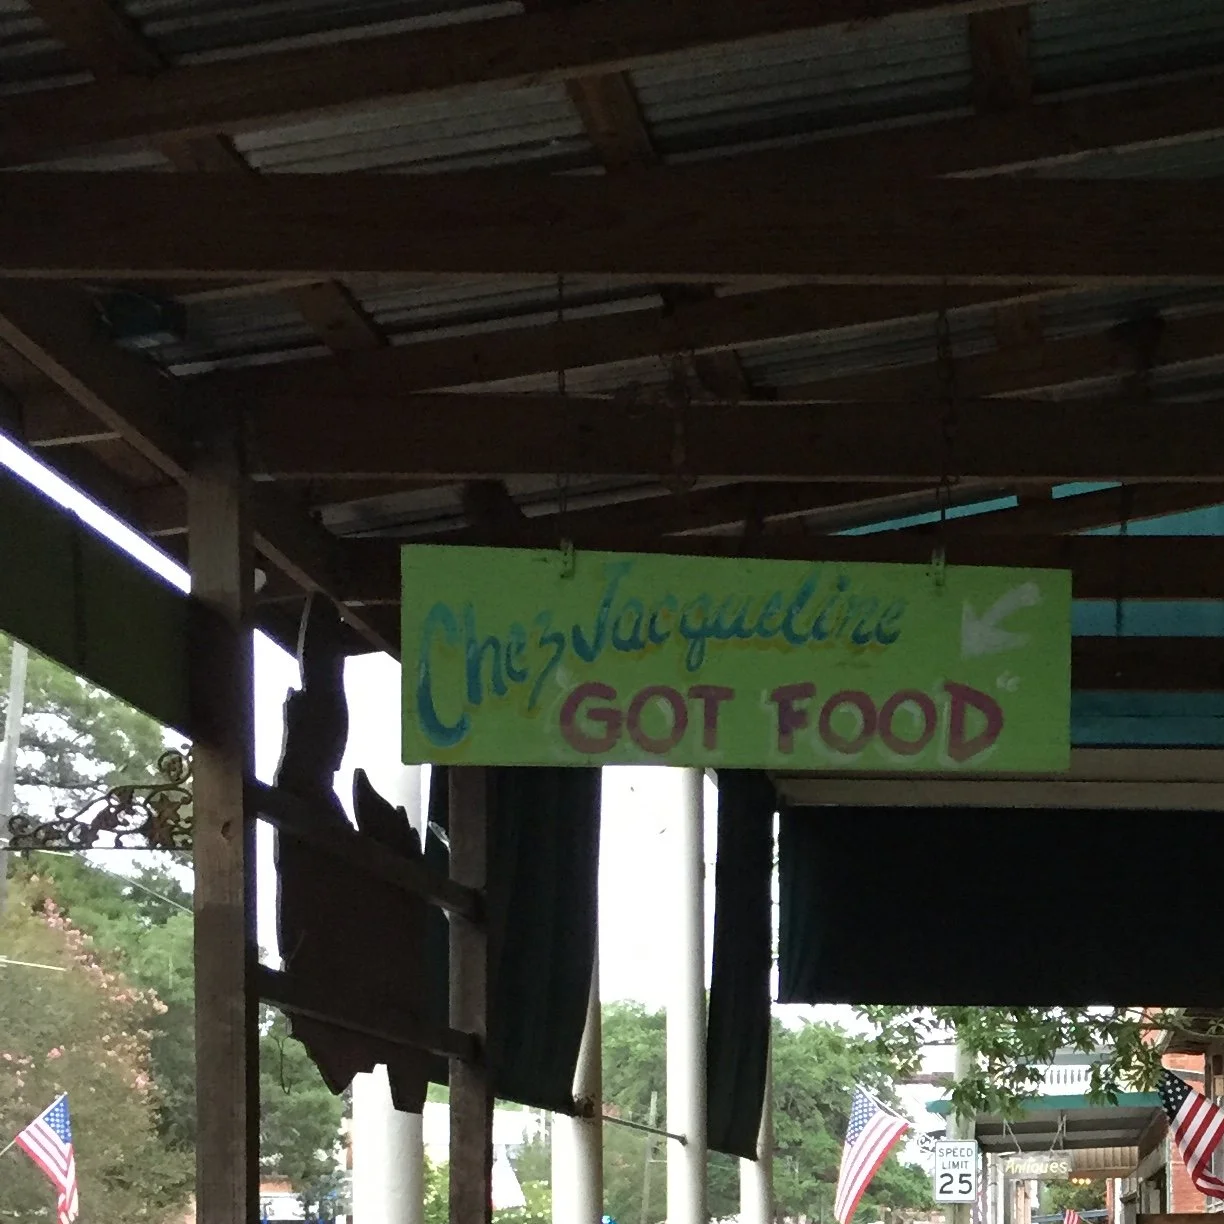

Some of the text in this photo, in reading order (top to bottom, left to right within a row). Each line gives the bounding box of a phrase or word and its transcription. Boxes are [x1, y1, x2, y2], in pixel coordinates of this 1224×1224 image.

[416, 560, 907, 744] Chez Jacqueline
[559, 680, 1005, 763] GOT FOOD
[938, 1147, 974, 1158] SPEED
[941, 1161, 969, 1171] LIMIT
[1005, 1158, 1069, 1175] Antiques
[938, 1172, 974, 1195] 25
